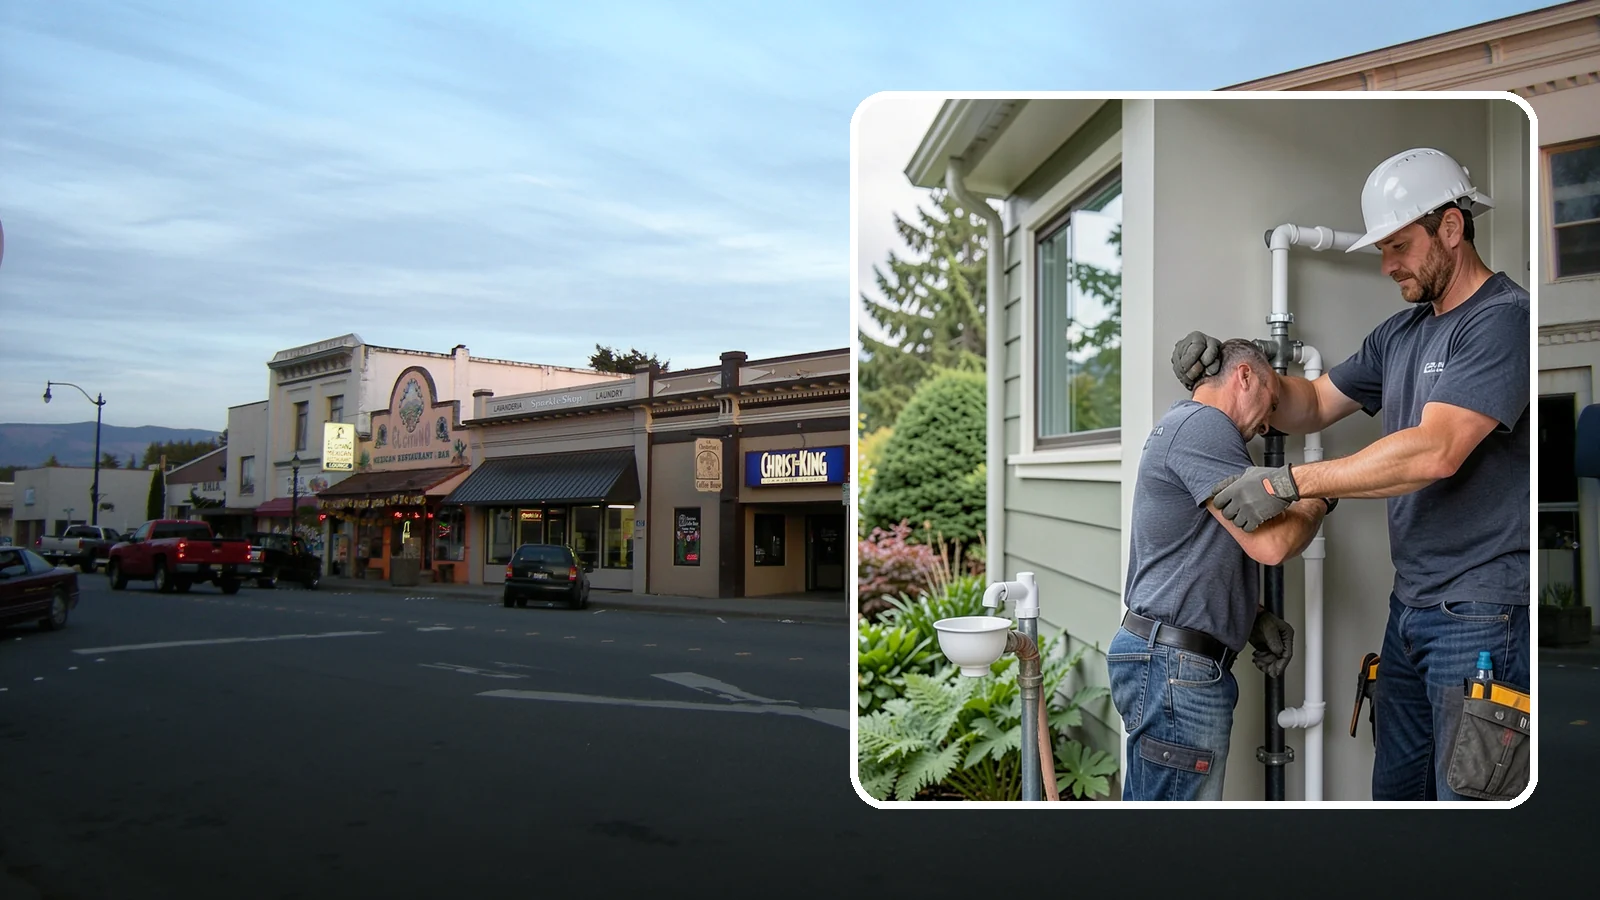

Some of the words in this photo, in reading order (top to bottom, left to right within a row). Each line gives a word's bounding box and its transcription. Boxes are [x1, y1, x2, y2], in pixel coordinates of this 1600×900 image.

[531, 396, 561, 409] Sparkle
[562, 394, 583, 404] Shop
[595, 389, 623, 400] LAUNDRY
[493, 402, 523, 412] LAVANDERIA
[374, 455, 396, 464] MEXICAN
[397, 452, 433, 462] RESTAURANT
[438, 450, 450, 459] BAR
[761, 452, 797, 478] CHRIST
[799, 450, 827, 476] KING
